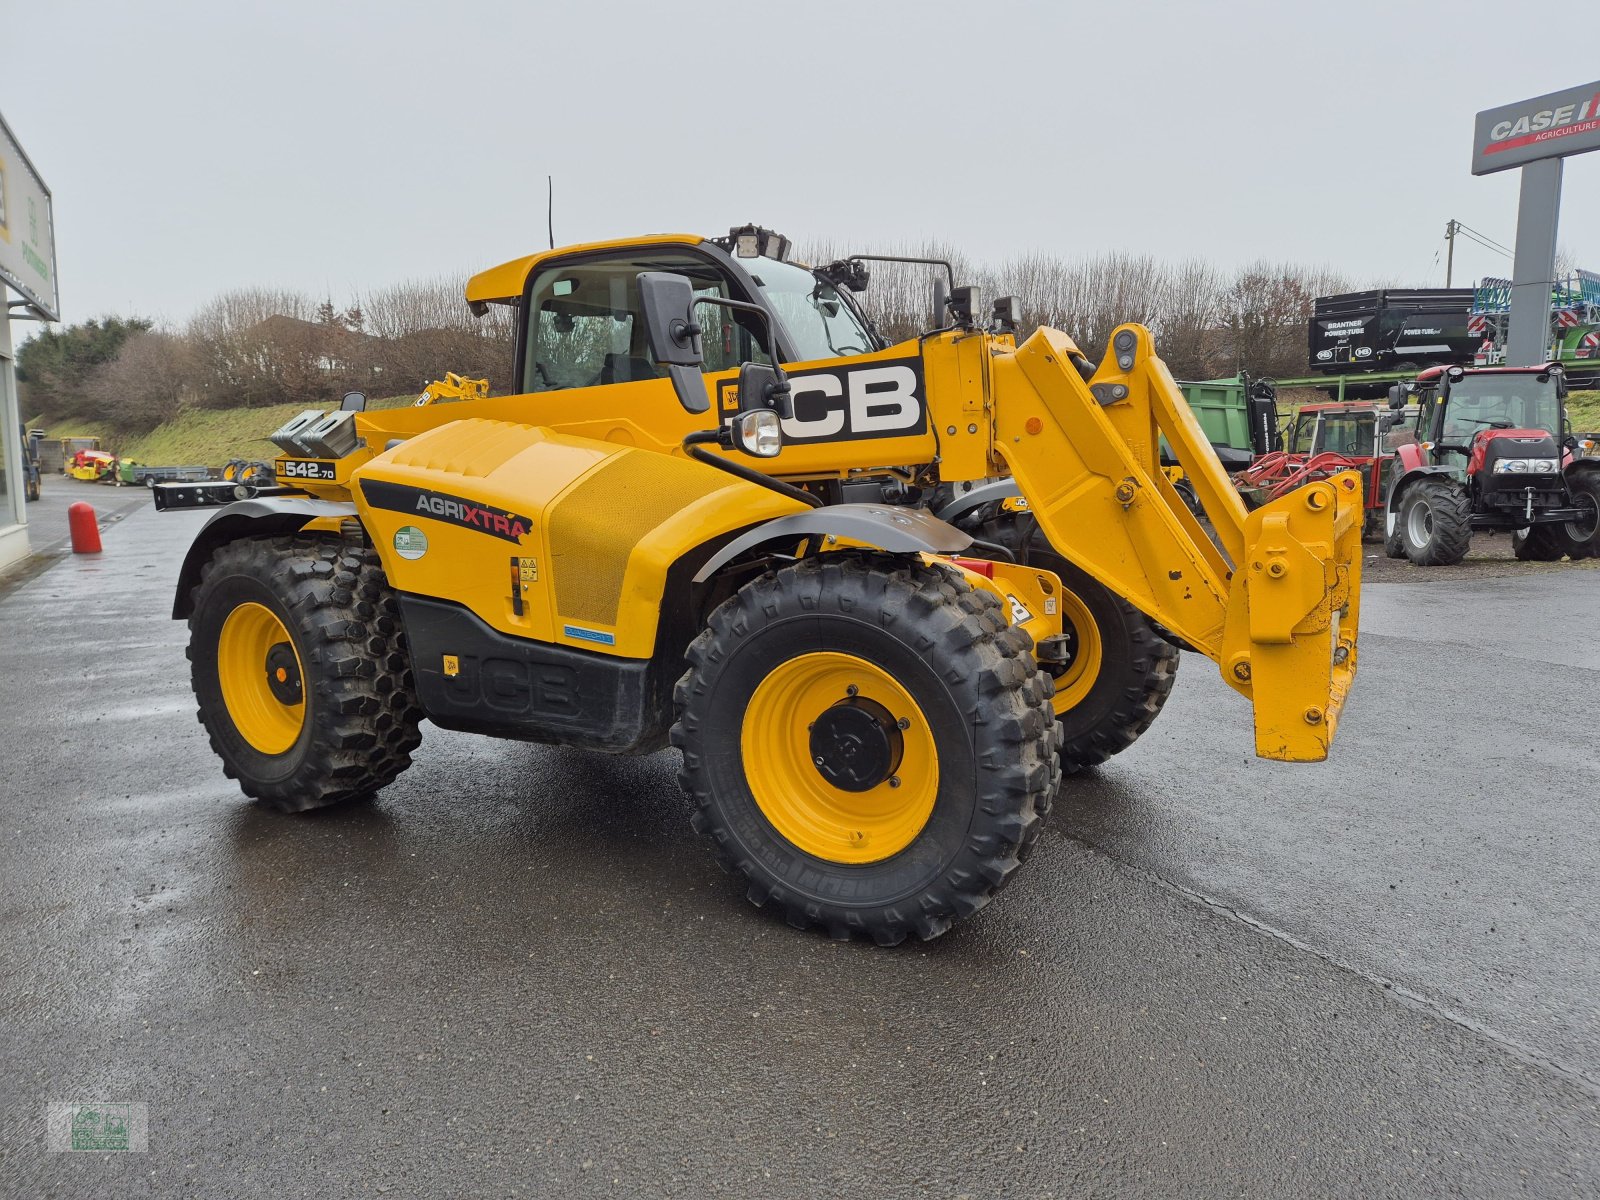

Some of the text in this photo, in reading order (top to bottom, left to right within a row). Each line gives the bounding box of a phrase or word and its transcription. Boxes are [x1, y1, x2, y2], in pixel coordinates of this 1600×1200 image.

[1490, 103, 1576, 141] CASE
[1535, 121, 1597, 141] AGRICULTURE
[1324, 328, 1365, 337] POWER-TUBE
[1327, 320, 1363, 329] BRANTNER
[780, 365, 921, 438] CB
[285, 461, 334, 479] 542-70
[416, 494, 525, 537] AGRIXTRA
